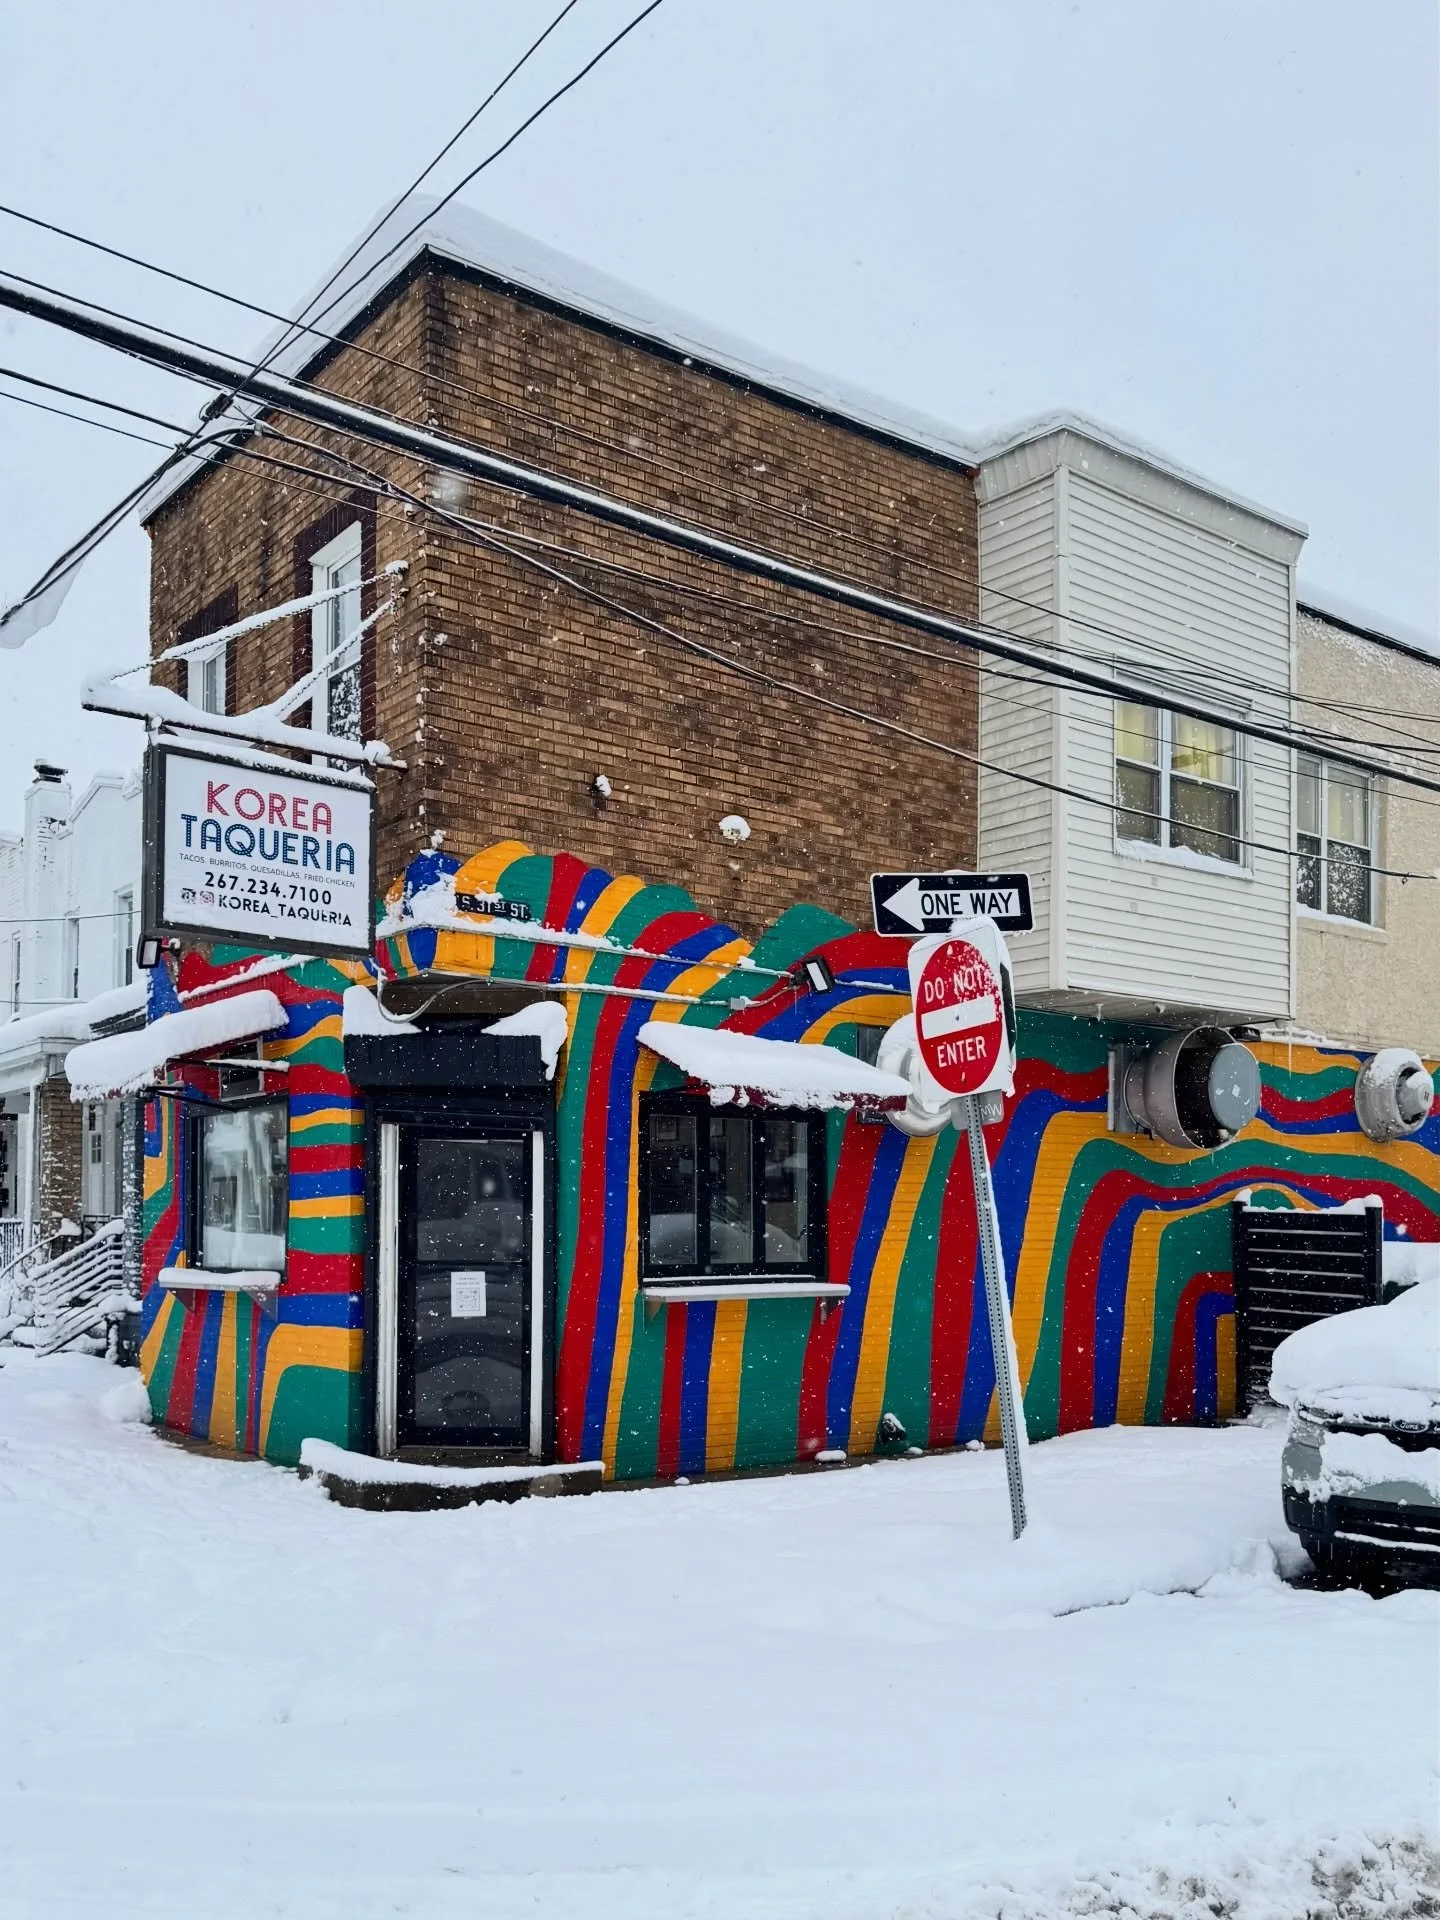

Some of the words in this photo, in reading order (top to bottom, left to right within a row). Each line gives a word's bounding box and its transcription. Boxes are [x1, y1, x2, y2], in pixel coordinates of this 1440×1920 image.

[207, 781, 332, 834] KOREA
[181, 814, 355, 875] TAQUERIA
[205, 871, 331, 905] 267.234.7100
[304, 873, 324, 883] FRIED
[325, 877, 355, 888] CHICKEN
[218, 894, 352, 927] KOREA_TAQUERIA
[510, 903, 528, 919] ST.
[921, 893, 963, 916] ONE
[969, 892, 1013, 915] WAY
[924, 977, 945, 1003] DO
[953, 964, 984, 996] NOT
[937, 1035, 987, 1068] ENTER
